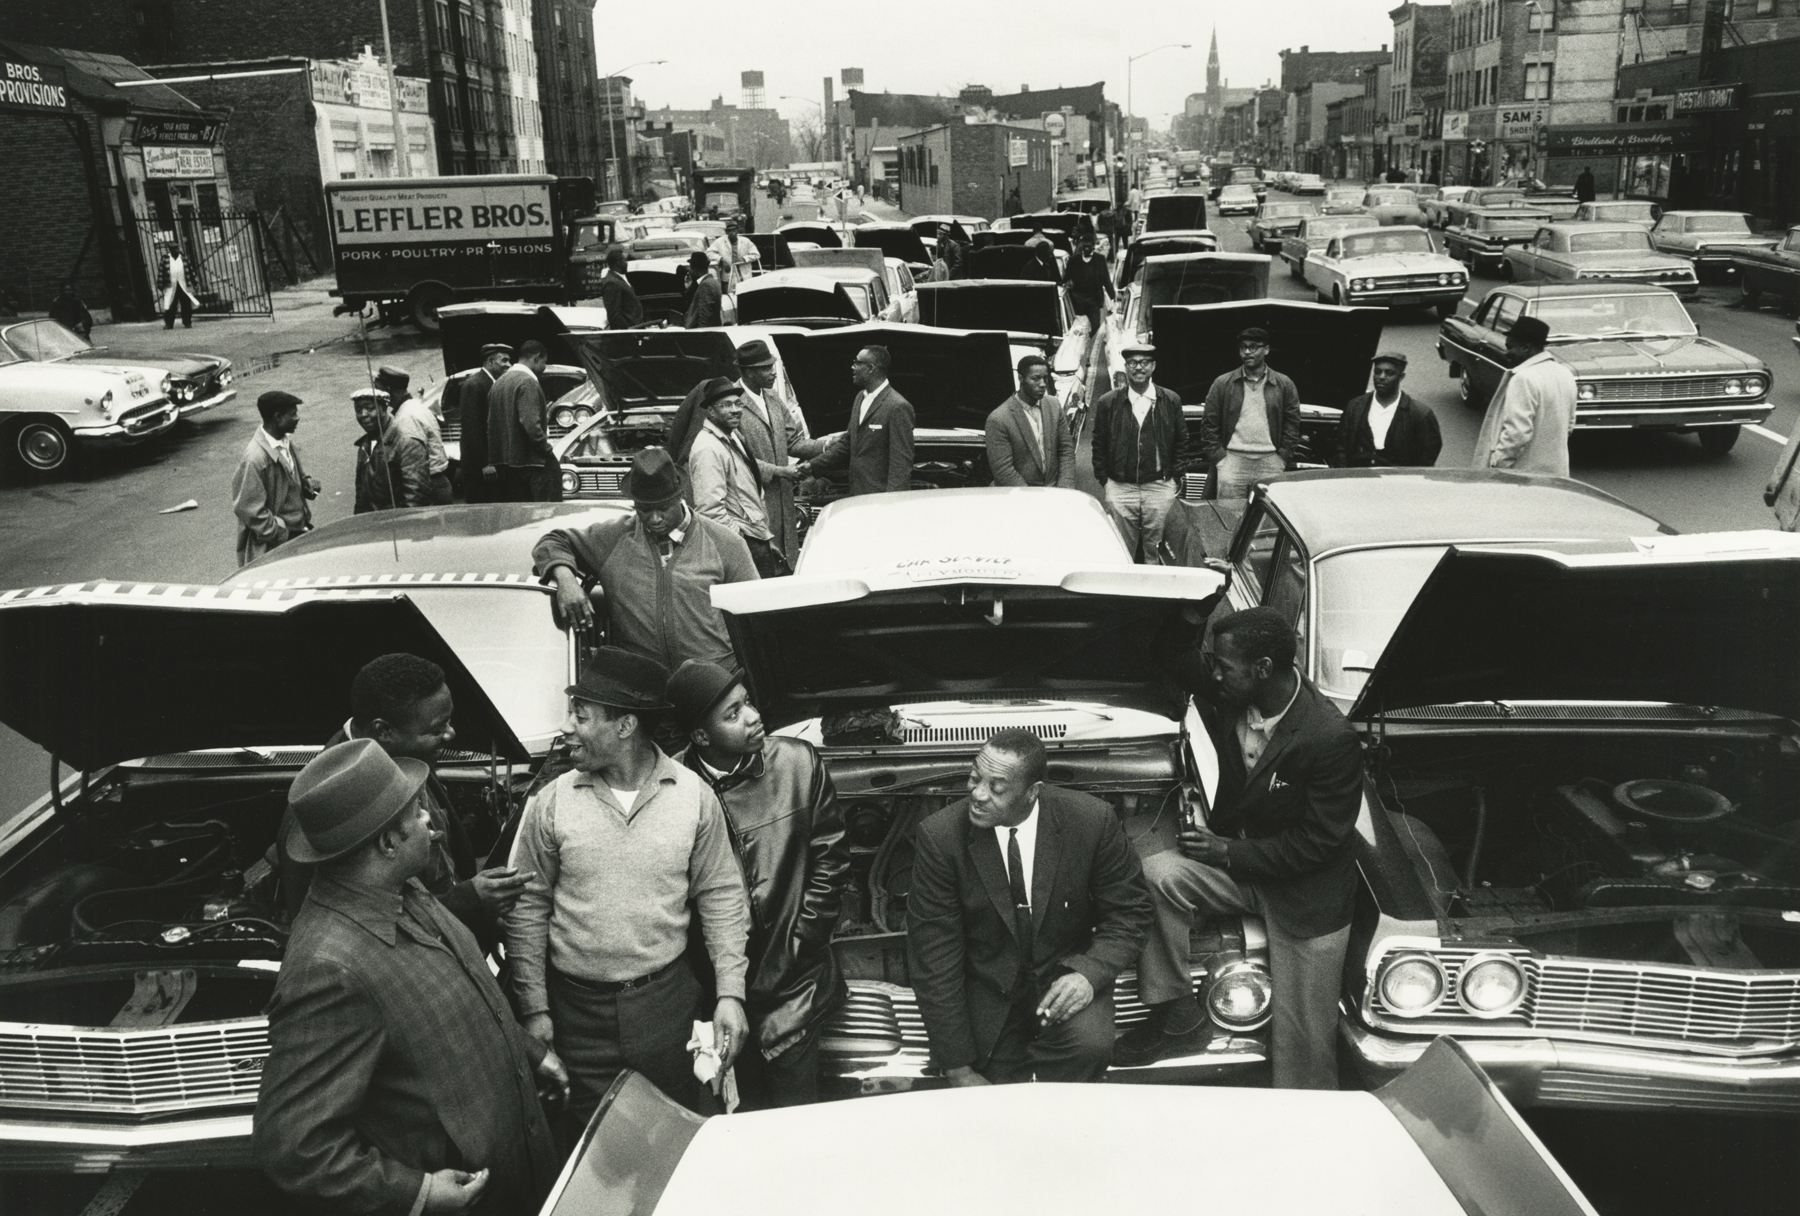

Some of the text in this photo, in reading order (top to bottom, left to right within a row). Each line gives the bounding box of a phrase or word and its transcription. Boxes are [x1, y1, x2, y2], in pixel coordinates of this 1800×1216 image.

[5, 62, 43, 81] BROS.
[0, 79, 66, 107] PROVISIONS
[1676, 87, 1734, 110] RESTAURANT
[1502, 110, 1542, 123] SAM'S
[1571, 135, 1618, 146] Birdland
[1627, 133, 1673, 145] Brooklyn
[179, 156, 213, 169] REAL ESTATE
[369, 194, 397, 202] QUALITY
[398, 193, 416, 201] MEAT
[336, 202, 550, 234] LEFFLER BROS.
[341, 244, 553, 261] PORK POULTRY PRVISIONS
